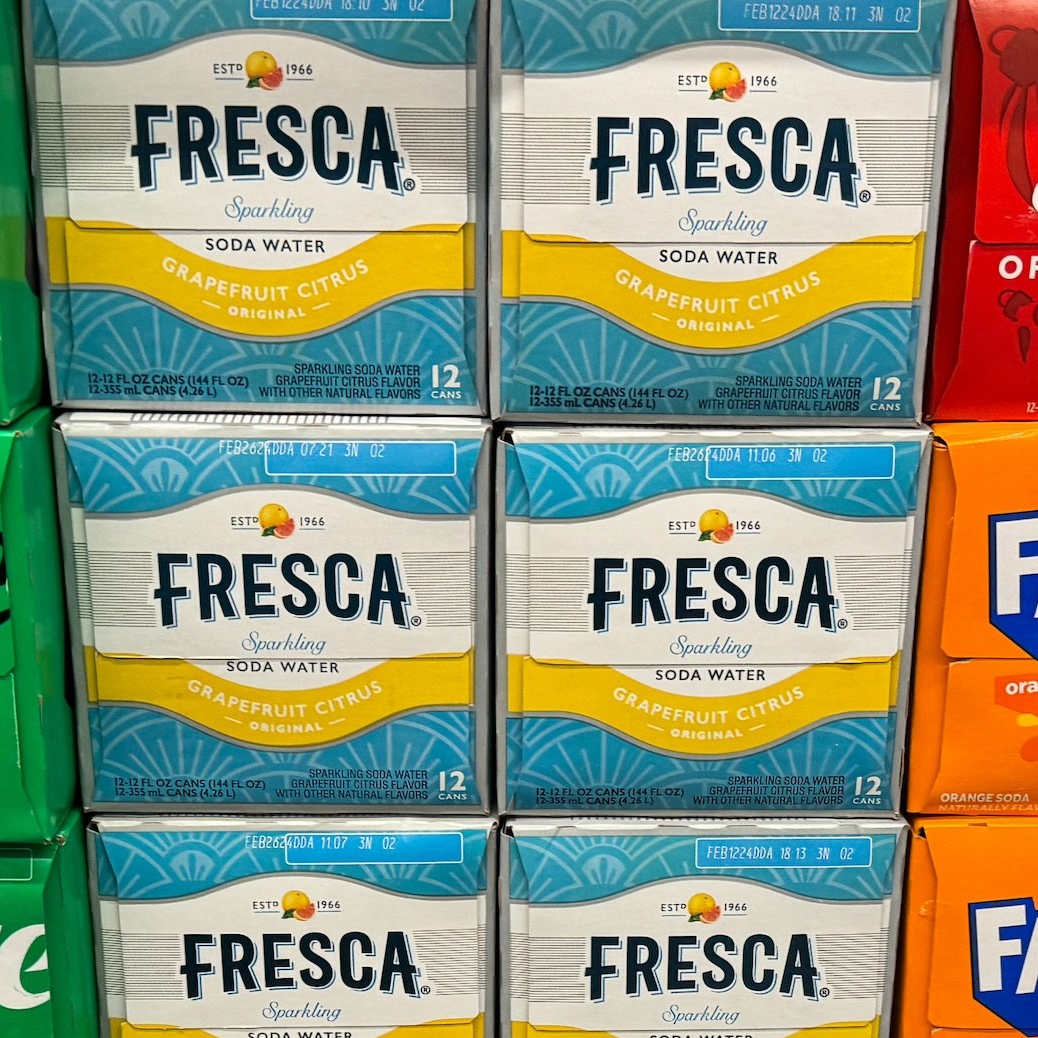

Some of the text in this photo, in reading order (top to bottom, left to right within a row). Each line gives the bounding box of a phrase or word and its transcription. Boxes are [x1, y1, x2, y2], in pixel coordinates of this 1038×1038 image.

[868, 6, 884, 22] 3N
[895, 7, 912, 23] 02
[286, 64, 313, 76] 1966
[130, 104, 406, 196] FRESCA
[589, 115, 858, 208] FRESCA
[225, 196, 314, 224] Sparkling
[679, 208, 768, 237] Sparkling
[205, 238, 325, 254] SODA WATER
[659, 249, 779, 265] SODA WATER
[161, 256, 370, 303] GRAPEFRUIT CITRUS
[615, 268, 821, 314] GRAPEFRUIT CITRUS
[228, 305, 306, 320] ORIGINAL
[116, 374, 130, 384] FL
[132, 374, 149, 385] OZ
[151, 375, 185, 385] CANS
[188, 376, 209, 387] (144
[212, 376, 226, 386] FL
[227, 376, 250, 388] OZ)
[275, 375, 420, 387] GRAPEFRUIT CITRUS FLAVOR
[294, 364, 420, 376] SPARKLING SODA WATER
[431, 364, 461, 388] 12
[259, 387, 421, 399] WITH OTHER NATURAL FLAVORS
[431, 390, 462, 399] CANS
[154, 552, 411, 629] FRESCA
[587, 555, 839, 633] FRESCA
[241, 631, 327, 655] Sparkling
[669, 635, 753, 659] Sparkling
[226, 660, 339, 674] SODA WATER
[655, 668, 766, 682] SODA WATER
[187, 679, 383, 718] GRAPEFRUIT CITRUS
[612, 686, 805, 724] GRAPEFRUIT CITRUS
[940, 792, 1030, 804] ORANGE SODA
[180, 930, 422, 1000] FRESCA
[584, 932, 820, 1003] FRESCA
[262, 1001, 342, 1022] Sparkling
[662, 1004, 740, 1025] Sparkling
